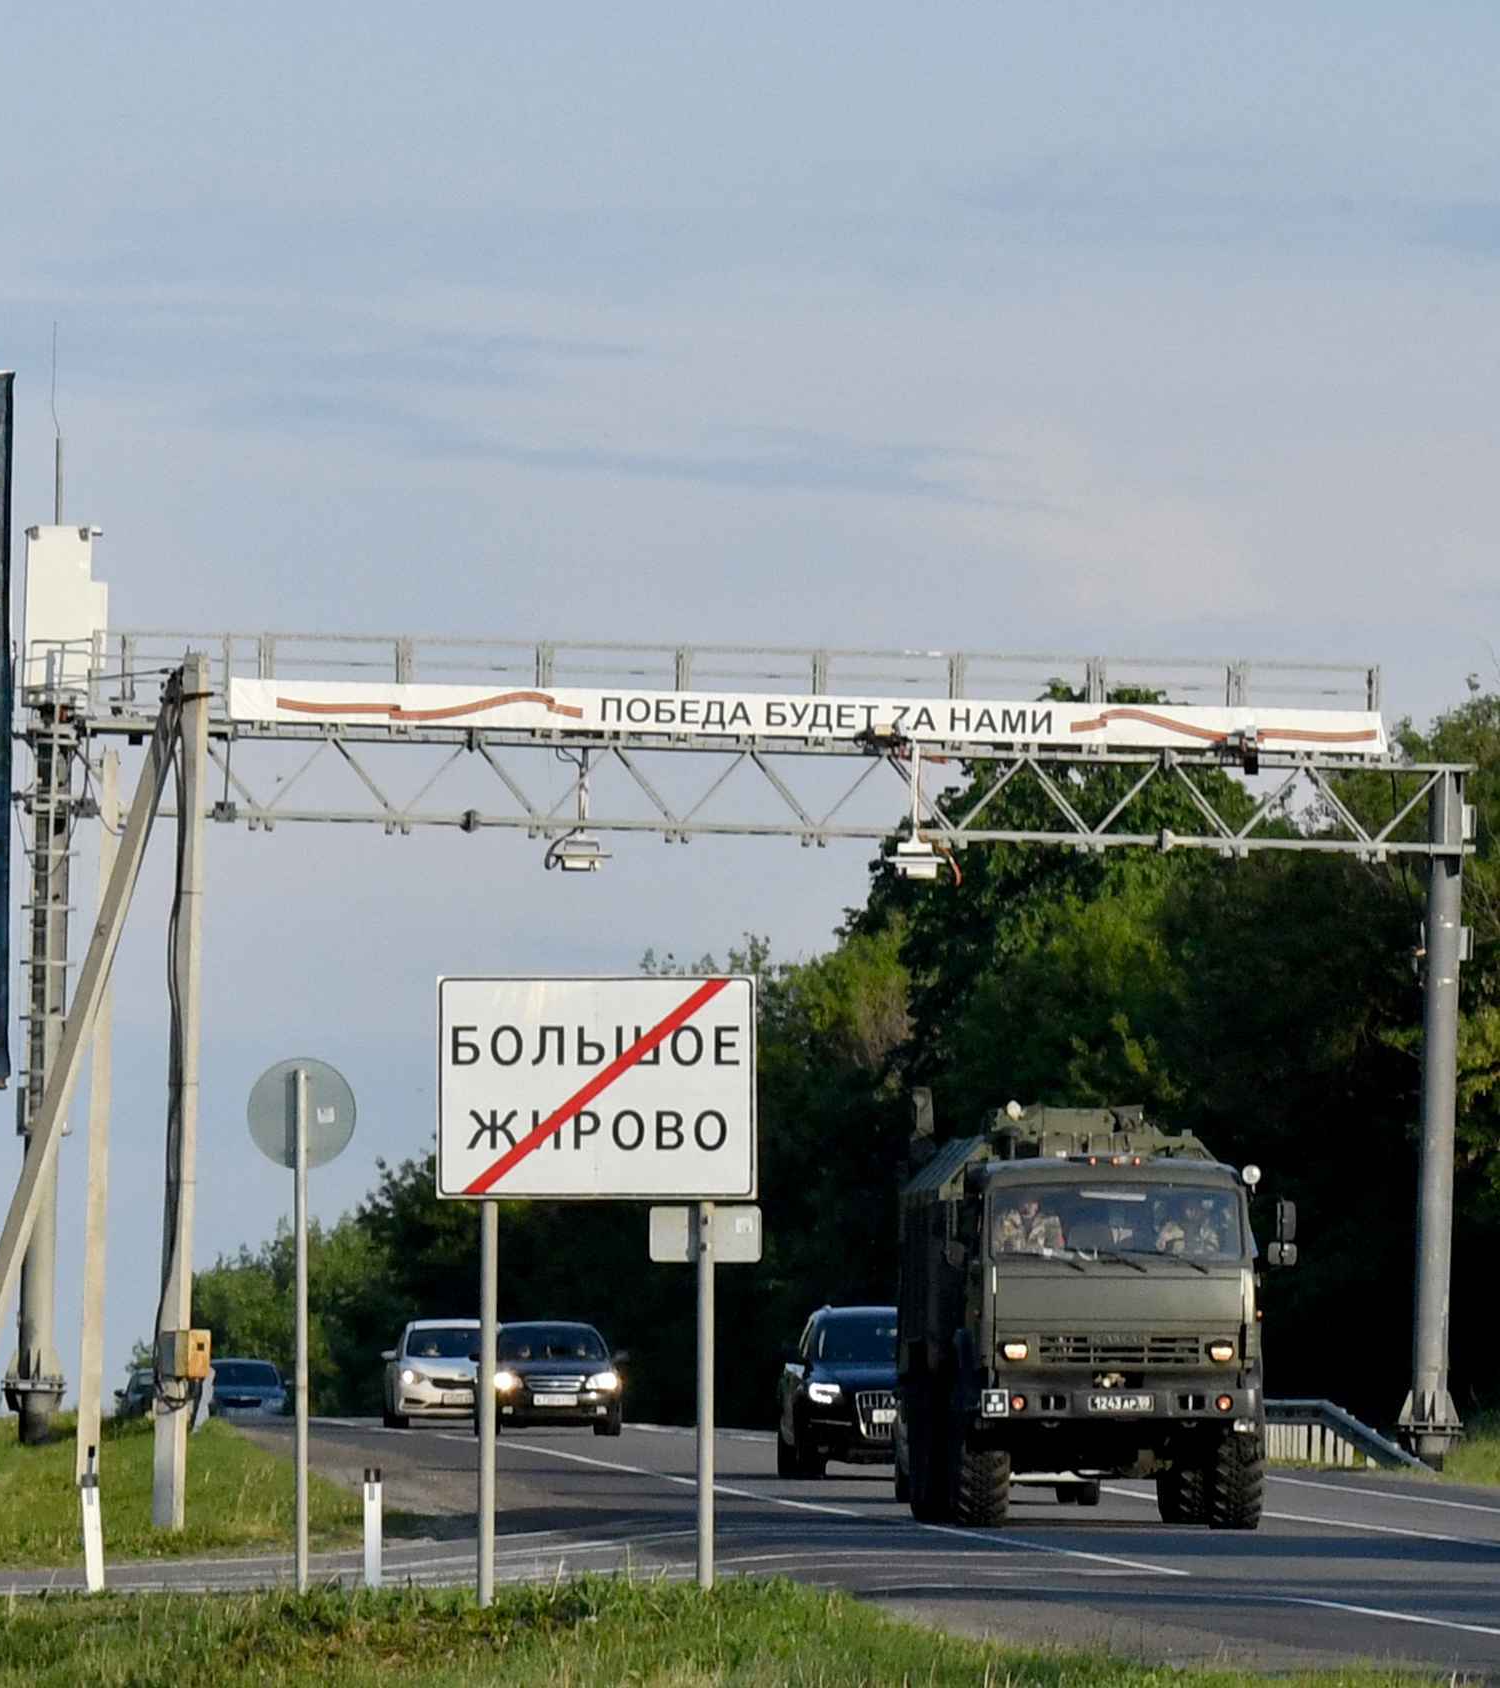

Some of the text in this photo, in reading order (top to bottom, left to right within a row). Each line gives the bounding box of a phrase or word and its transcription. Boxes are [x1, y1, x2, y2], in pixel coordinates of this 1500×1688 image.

[601, 697, 751, 731] ПОБЕДА
[765, 702, 879, 734] БУДЕТ
[949, 707, 1053, 735] НАМИ
[451, 1025, 740, 1067] БОЛЬШОЕ
